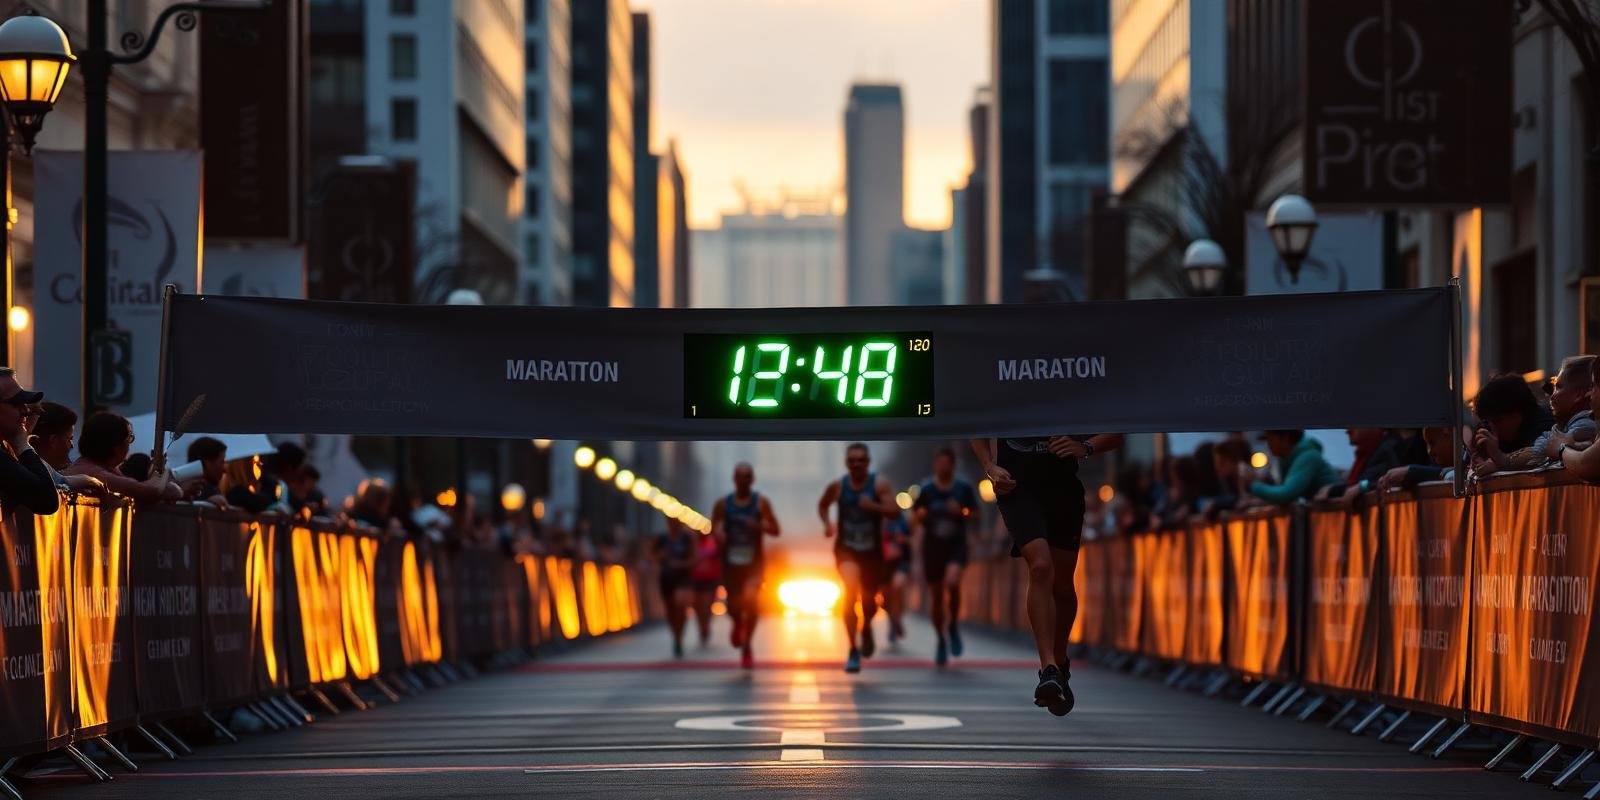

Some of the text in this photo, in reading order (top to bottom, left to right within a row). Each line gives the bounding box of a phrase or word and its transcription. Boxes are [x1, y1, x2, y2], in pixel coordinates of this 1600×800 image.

[909, 339, 930, 352] 120
[506, 359, 619, 383] MARATTON
[728, 342, 898, 408] 12:48
[998, 356, 1106, 381] MARATON
